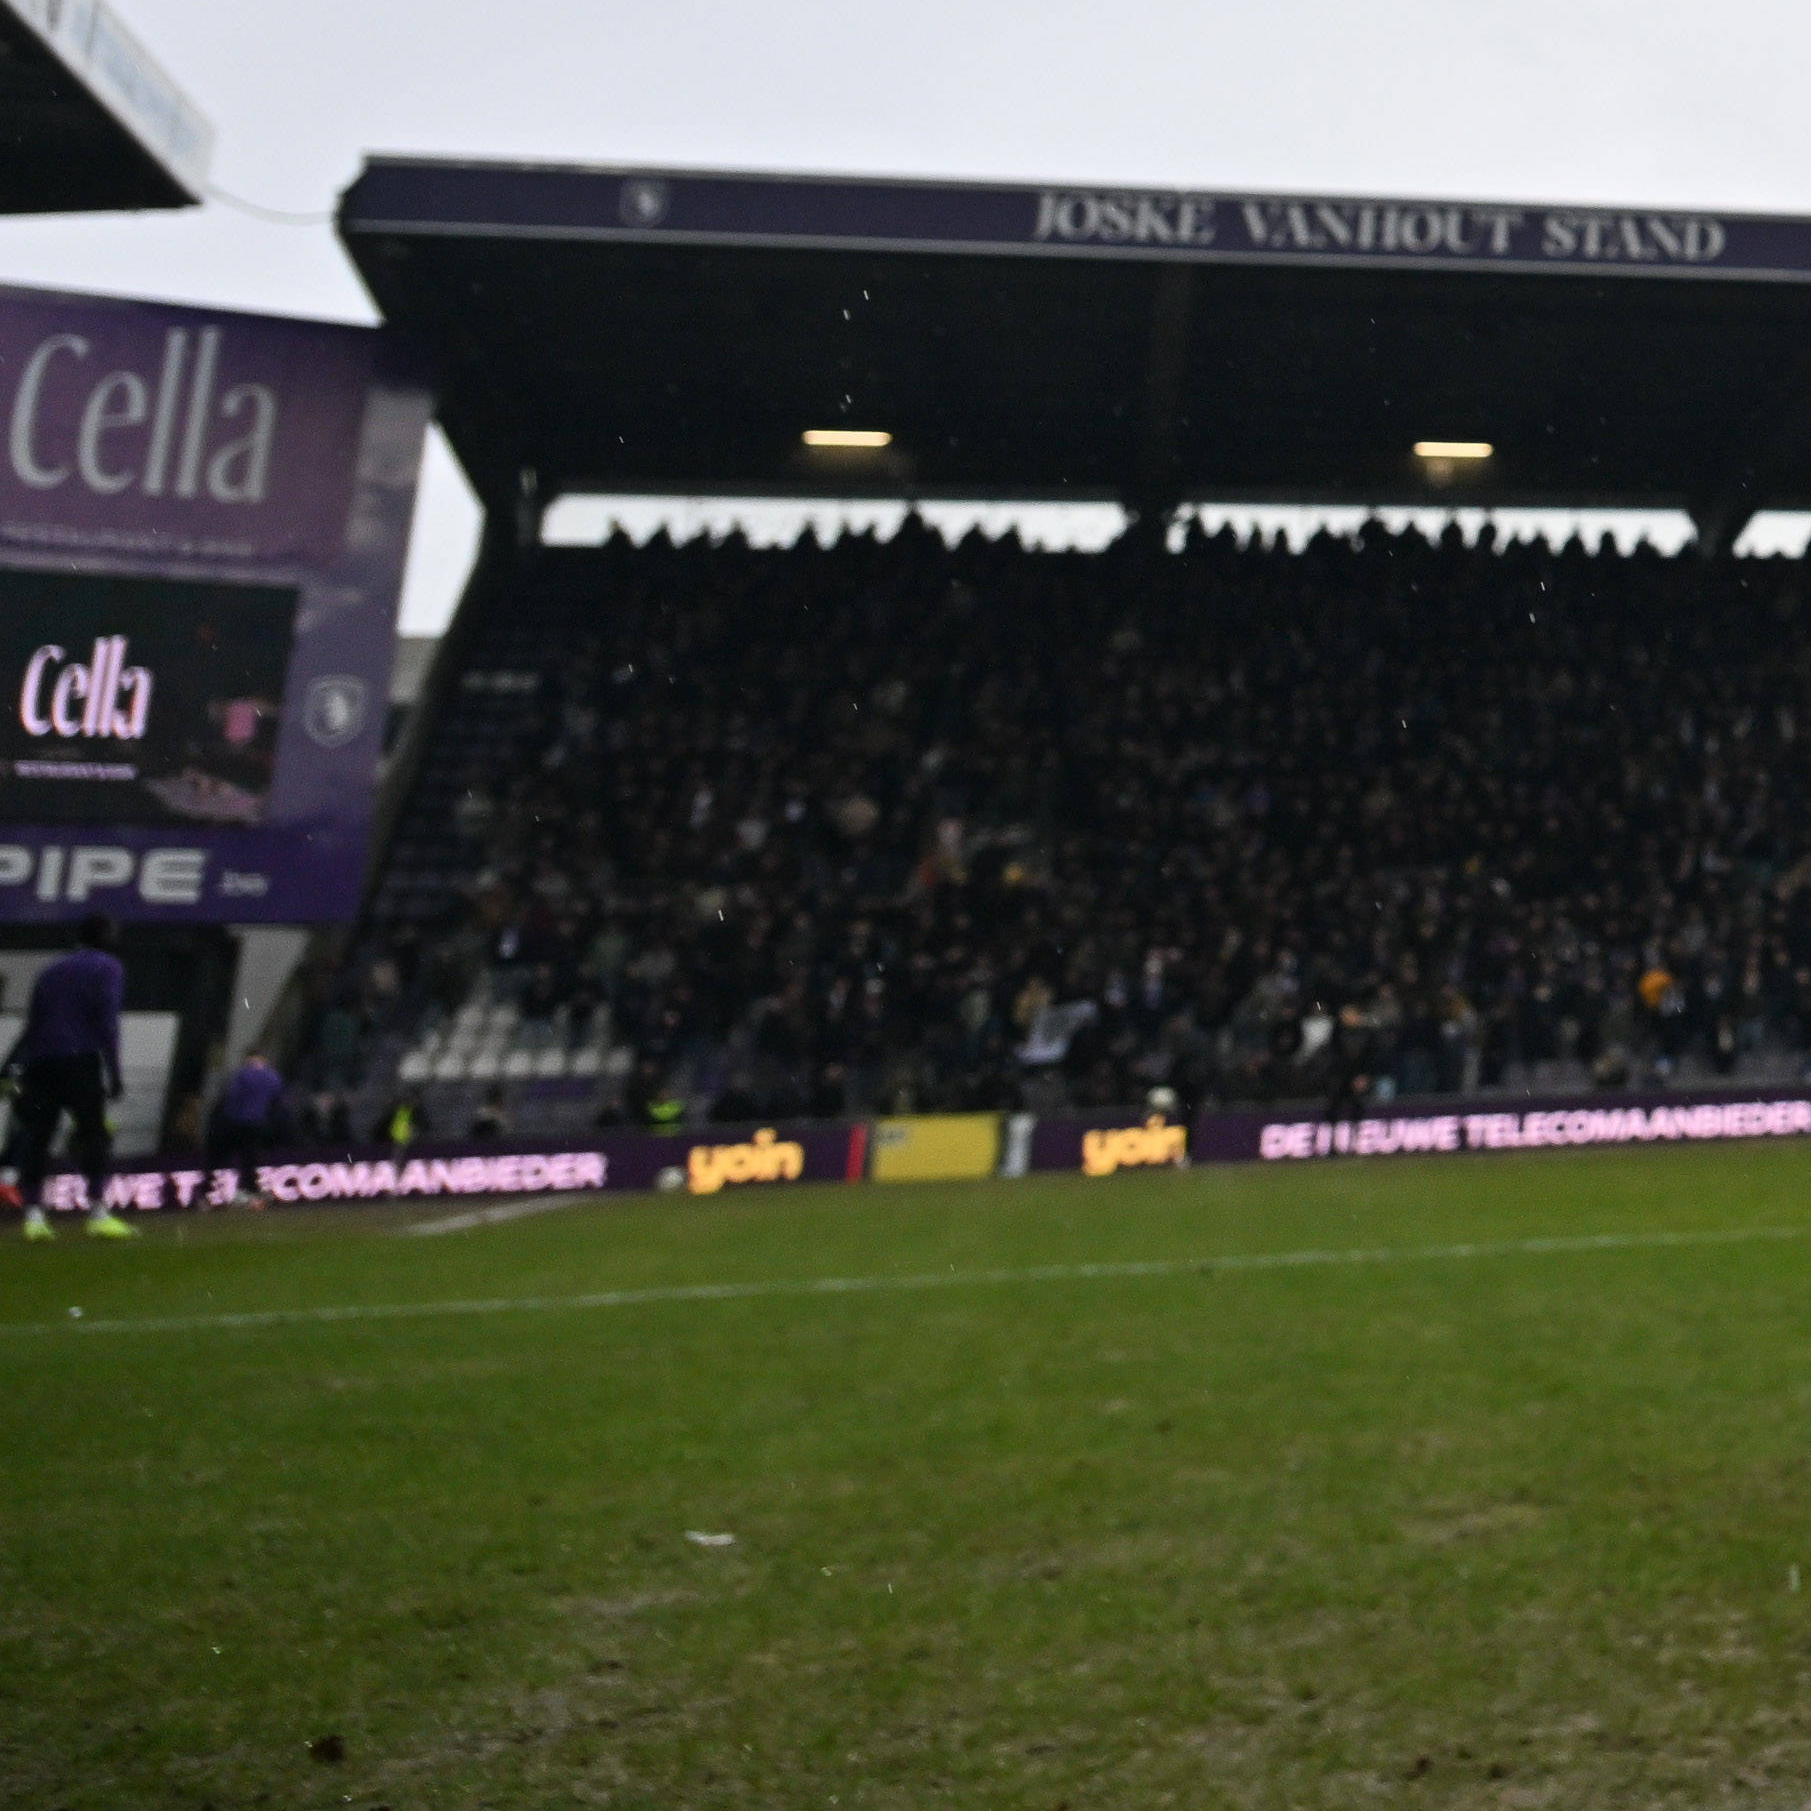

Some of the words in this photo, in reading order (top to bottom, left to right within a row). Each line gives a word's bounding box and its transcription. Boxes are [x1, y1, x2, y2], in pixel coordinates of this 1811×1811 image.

[1033, 190, 1216, 245] JOSKE
[1239, 199, 1525, 257] VANHOUT
[1541, 210, 1727, 265] STAND
[7, 323, 278, 504] Cella
[19, 634, 153, 740] Cella
